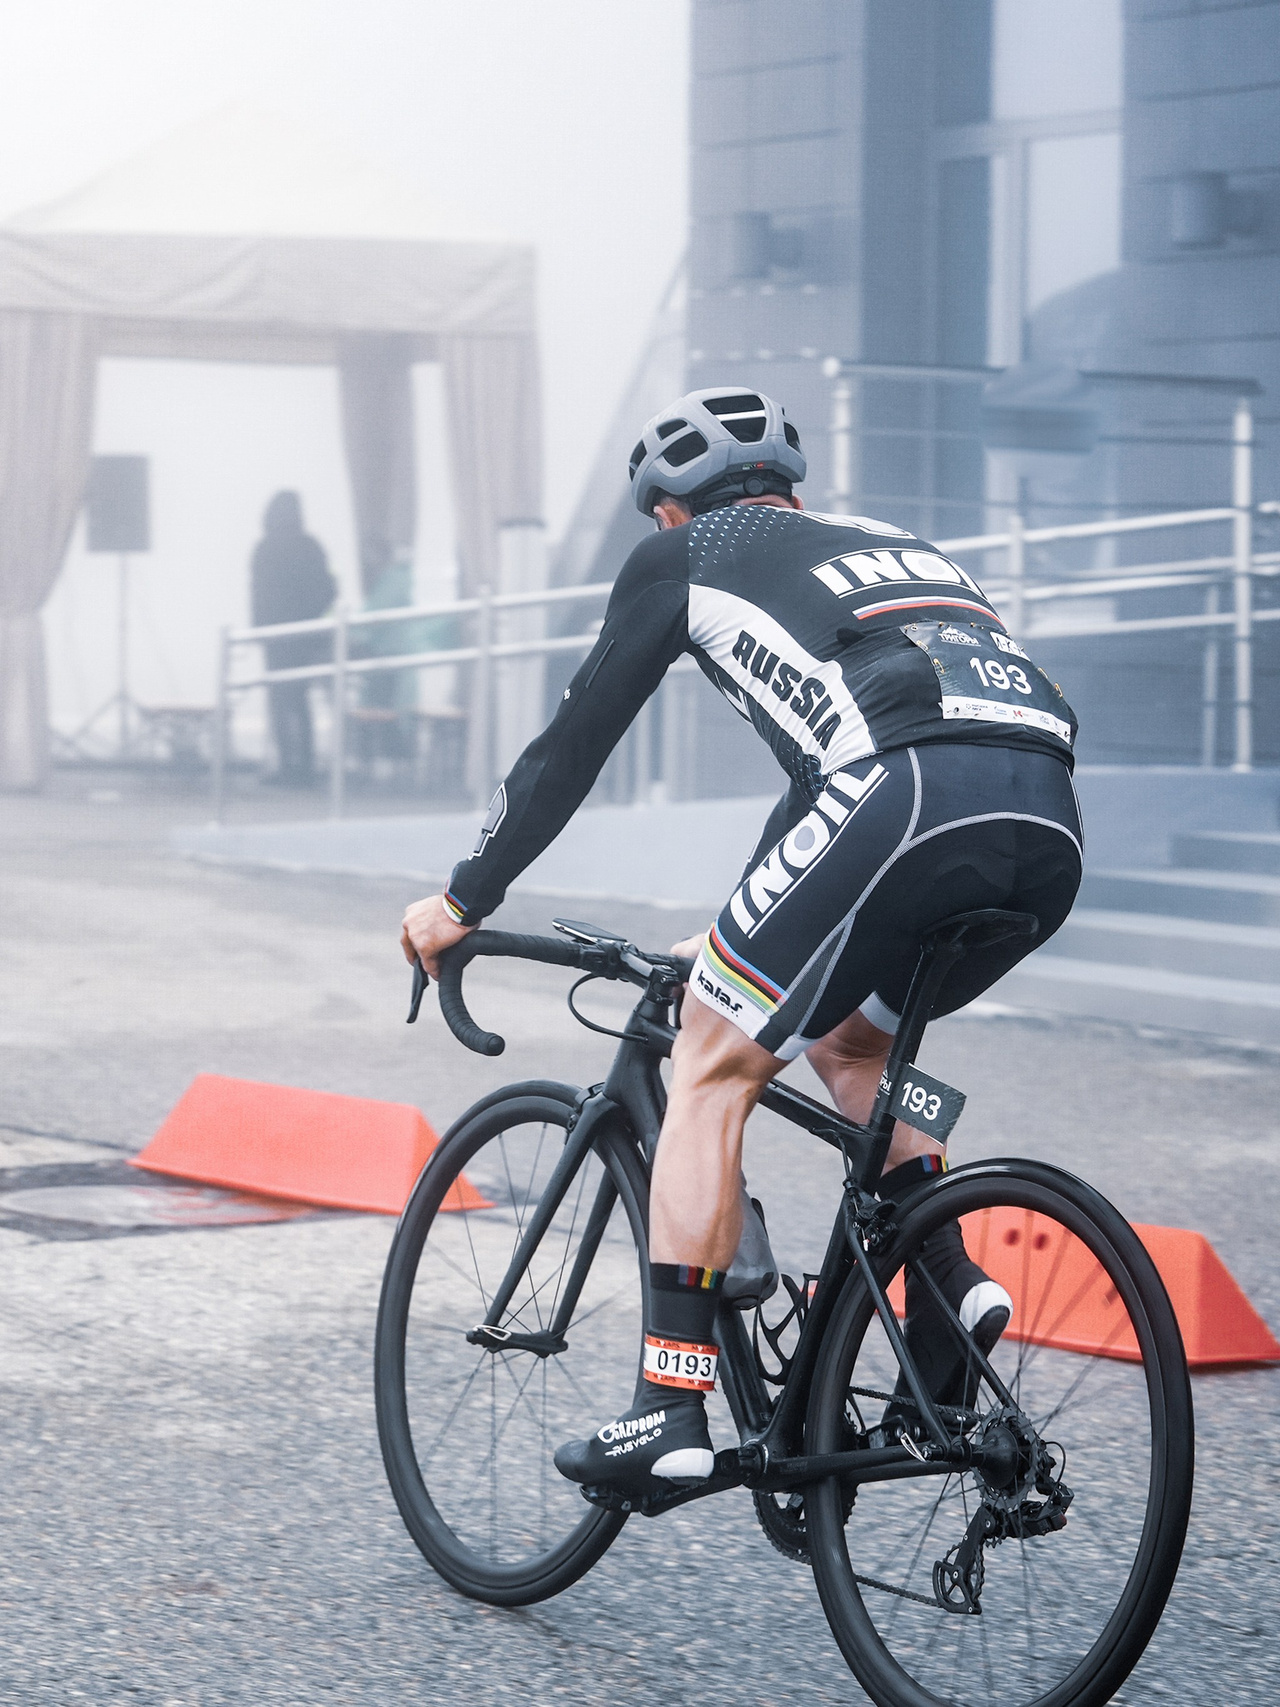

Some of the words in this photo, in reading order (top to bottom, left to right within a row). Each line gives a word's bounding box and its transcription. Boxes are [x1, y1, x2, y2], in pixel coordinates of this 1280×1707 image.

[732, 630, 842, 751] RUSSIA
[969, 657, 1032, 695] 193
[729, 762, 886, 936] INOIL
[697, 970, 743, 1012] kalas
[901, 1081, 942, 1121] 193
[657, 1350, 712, 1377] 0193
[597, 1410, 666, 1443] GAZPROM
